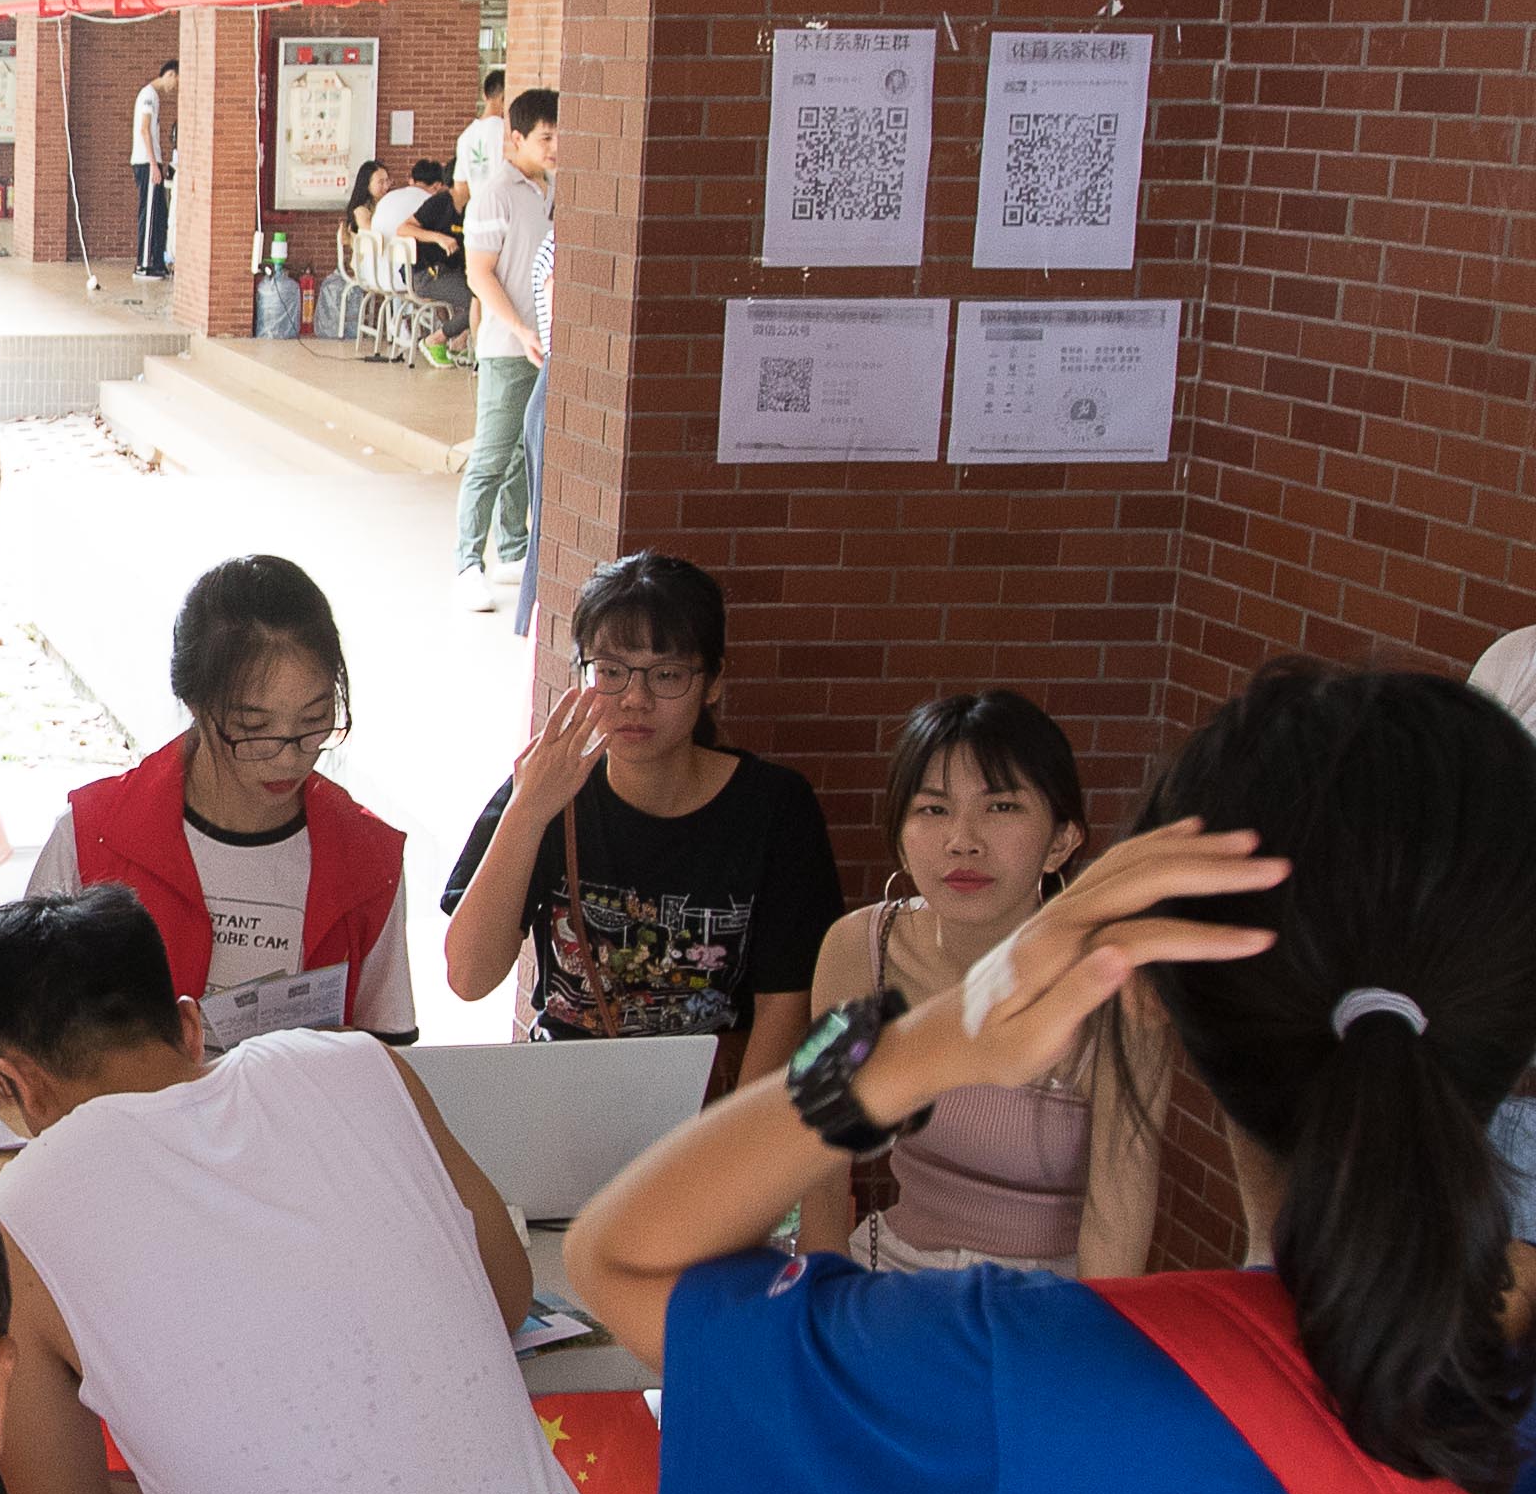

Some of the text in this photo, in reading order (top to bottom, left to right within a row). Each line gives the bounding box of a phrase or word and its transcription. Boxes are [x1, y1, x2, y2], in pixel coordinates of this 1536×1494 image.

[794, 32, 911, 52] 体育系新生群
[1012, 39, 1128, 60] 体育系家长群
[253, 935, 290, 950] CAM
